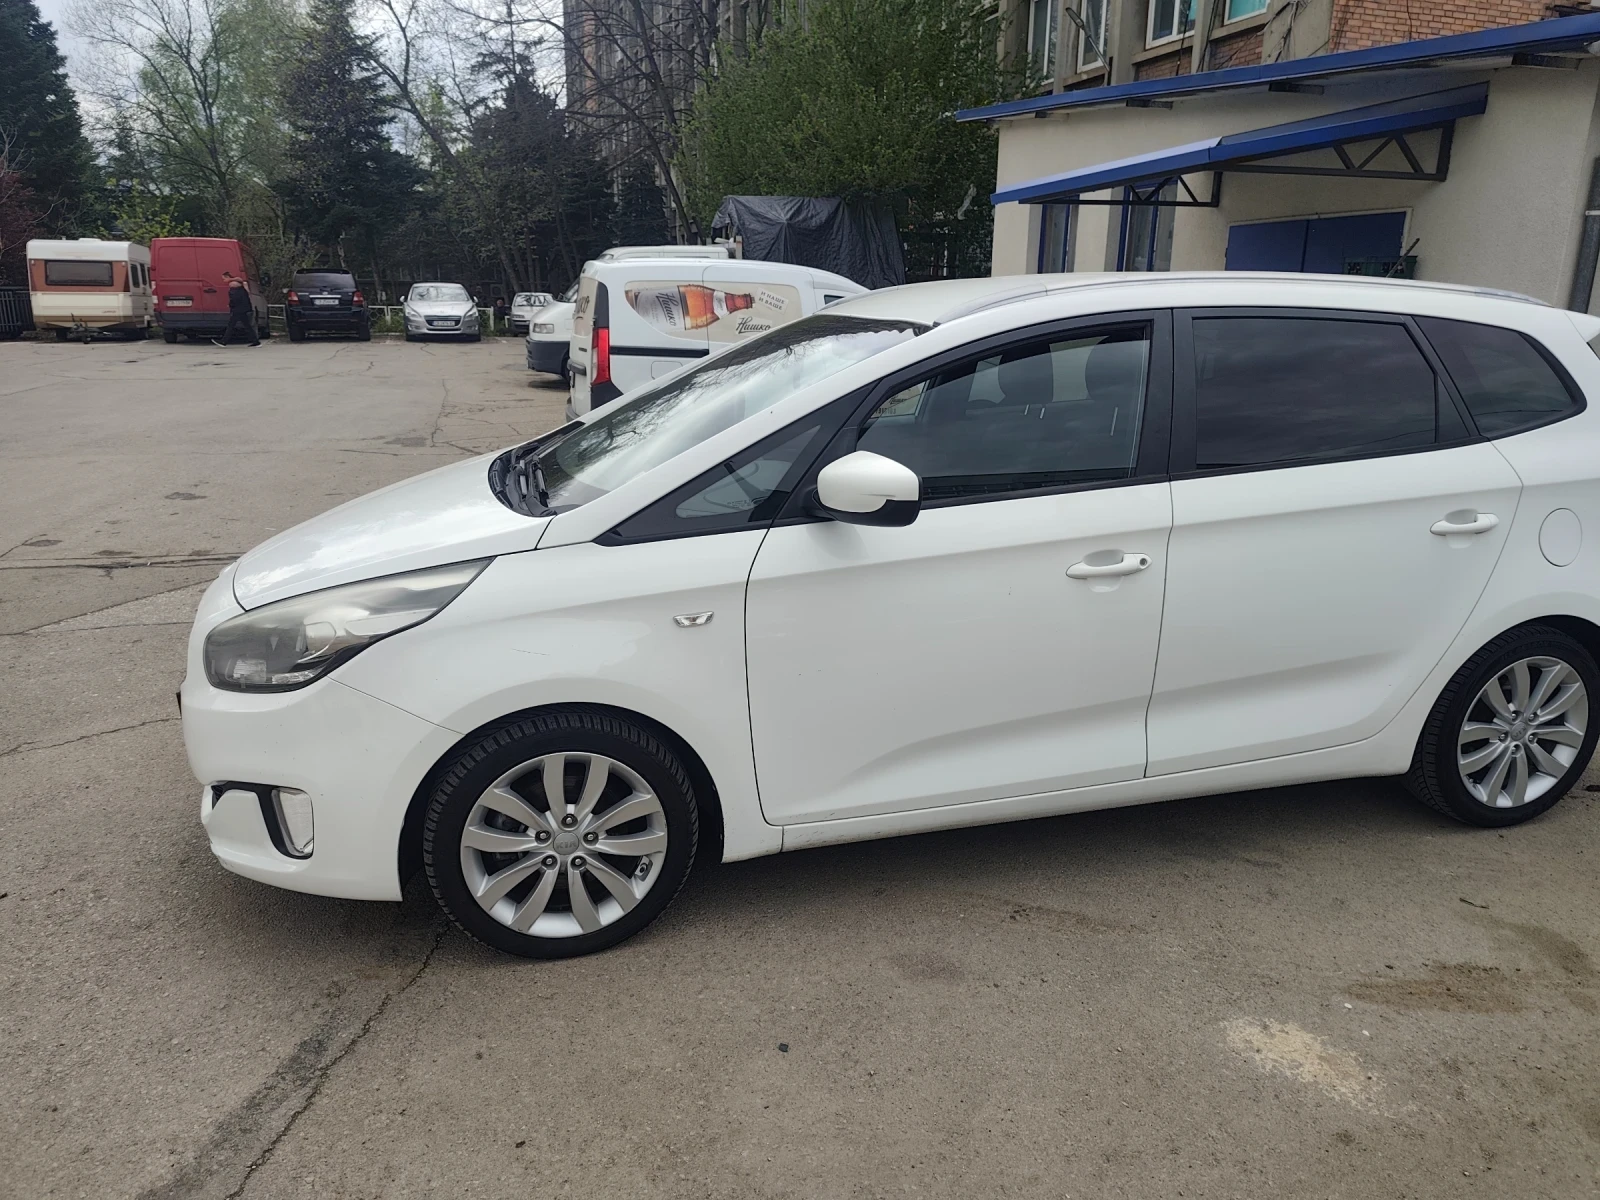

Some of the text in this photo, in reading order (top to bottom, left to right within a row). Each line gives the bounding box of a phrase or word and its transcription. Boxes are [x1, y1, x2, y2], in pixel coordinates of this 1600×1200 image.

[764, 299, 783, 311] ВАШЕ
[766, 293, 785, 305] НАШЕ
[655, 292, 680, 327] Нишко
[735, 316, 771, 334] Нишко
